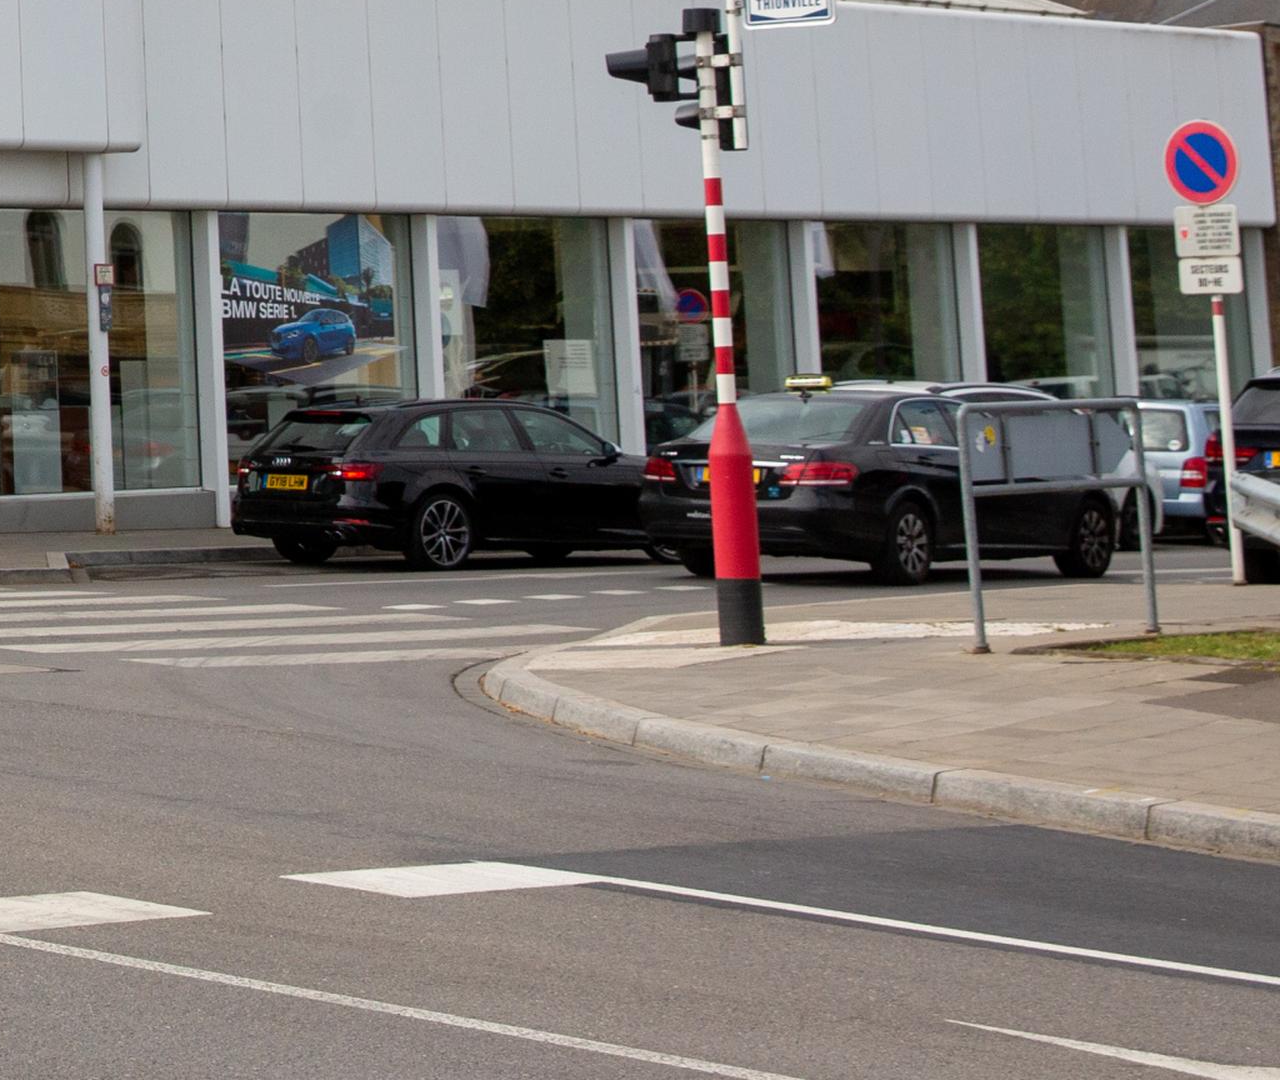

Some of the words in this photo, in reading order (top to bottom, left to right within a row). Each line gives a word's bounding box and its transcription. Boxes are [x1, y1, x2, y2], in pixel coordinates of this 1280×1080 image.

[1190, 264, 1229, 275] SECTEURS
[220, 277, 241, 296] LA
[242, 279, 282, 301] TOUTE
[283, 287, 321, 305] NOUVELLE
[220, 299, 257, 319] BMW
[259, 300, 289, 319] SÉRIE
